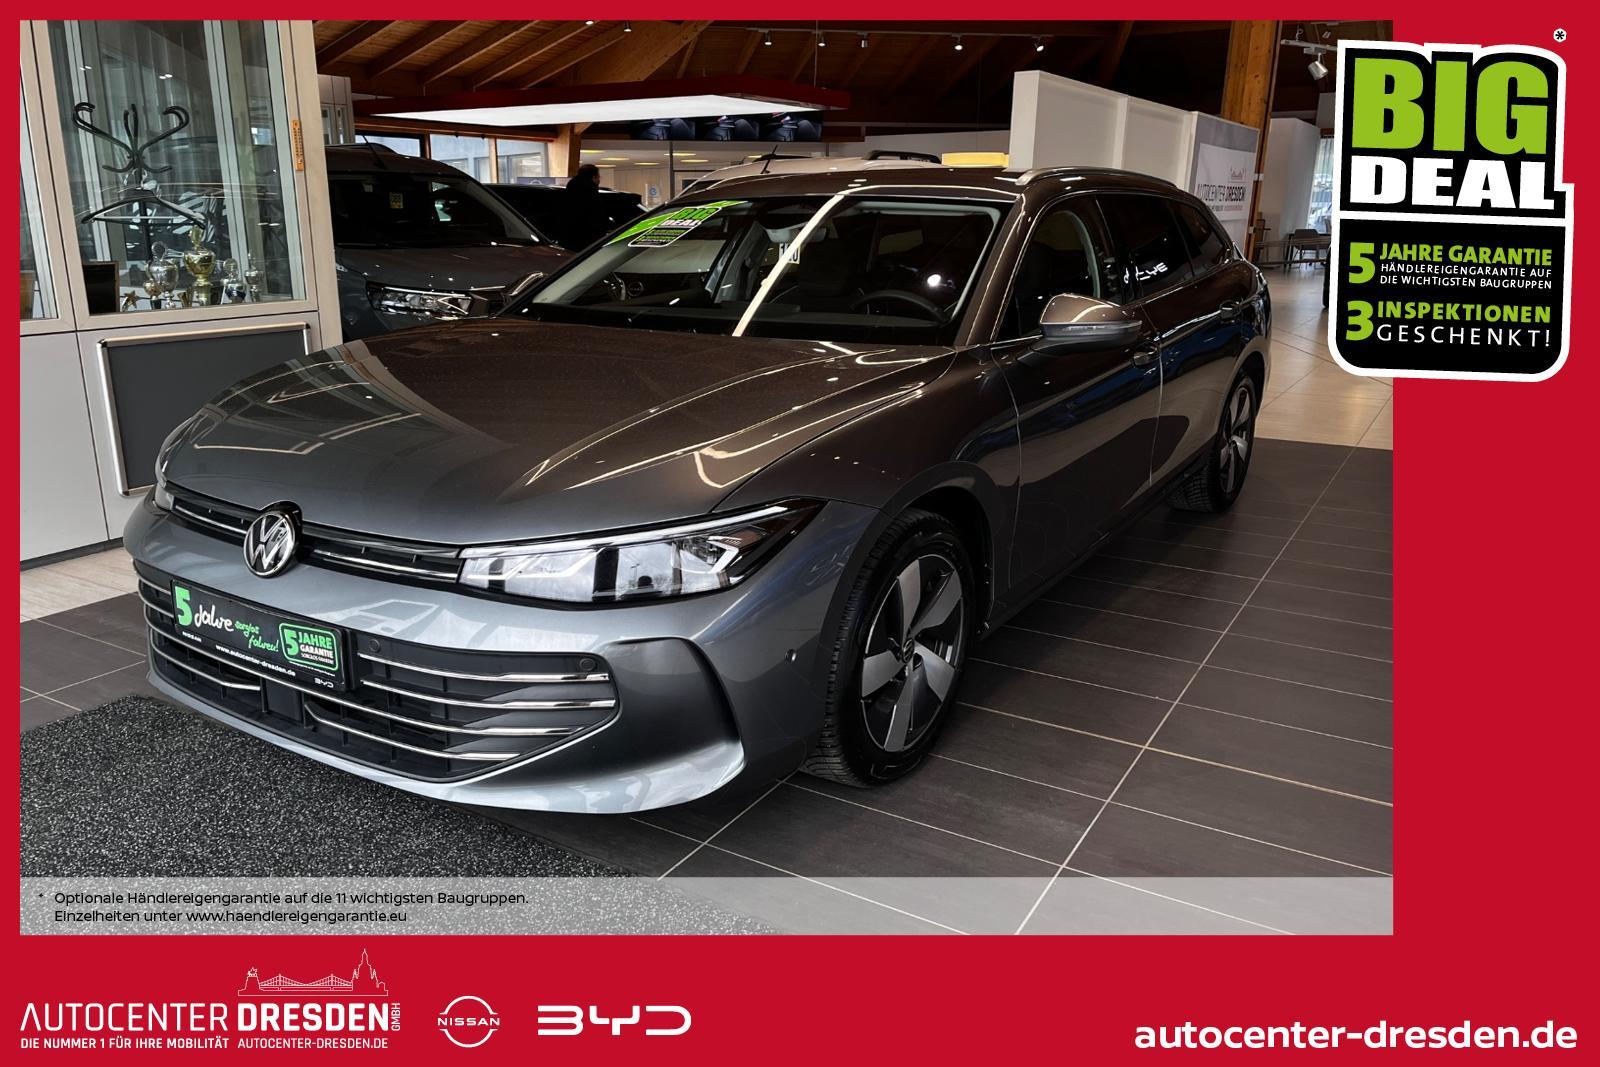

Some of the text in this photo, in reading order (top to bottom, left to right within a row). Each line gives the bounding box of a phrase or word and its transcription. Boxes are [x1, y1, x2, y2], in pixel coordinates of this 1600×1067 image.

[175, 586, 234, 632] 5 Jahre
[284, 629, 299, 656] 5
[298, 631, 333, 650] JAHRE
[300, 644, 334, 659] GARANTIE
